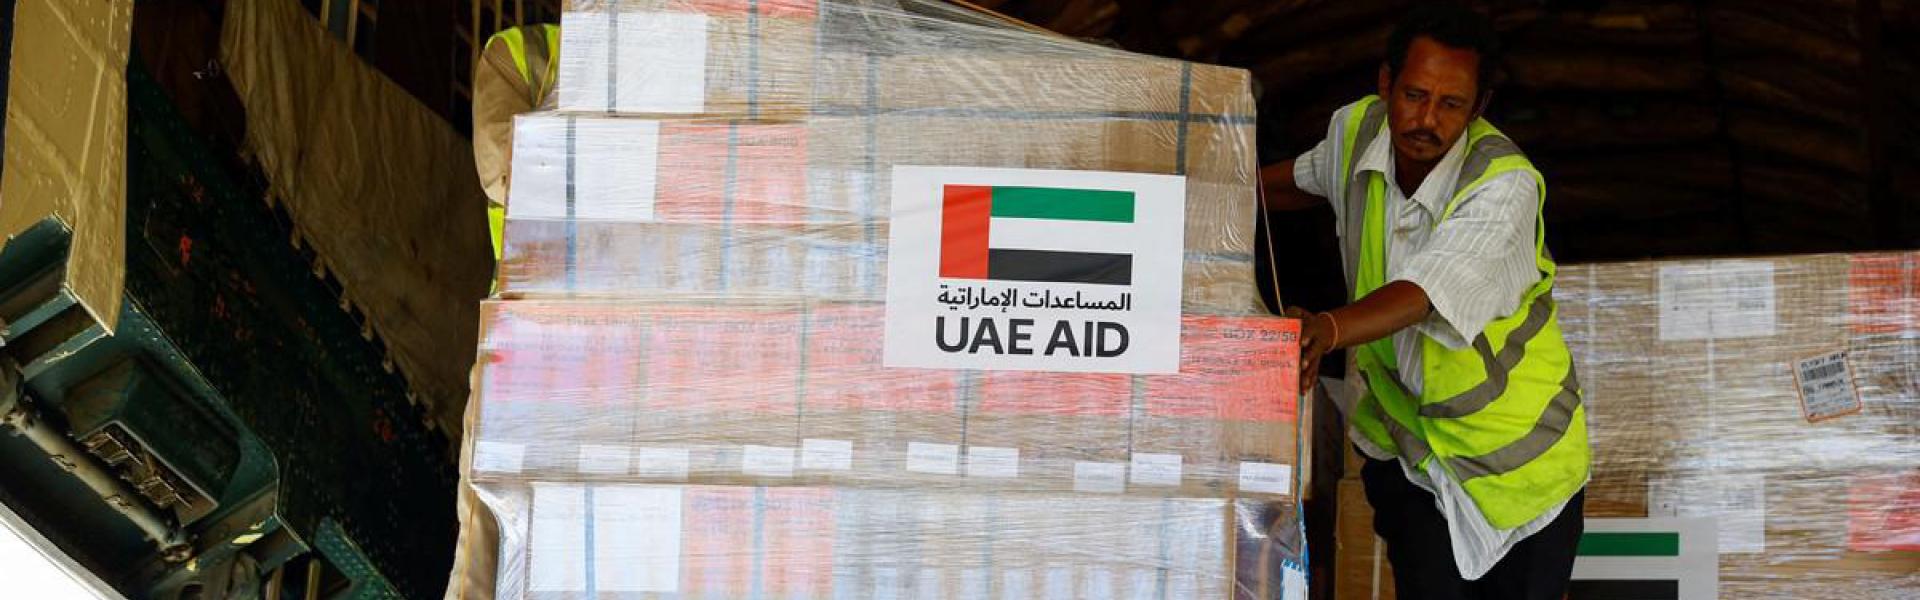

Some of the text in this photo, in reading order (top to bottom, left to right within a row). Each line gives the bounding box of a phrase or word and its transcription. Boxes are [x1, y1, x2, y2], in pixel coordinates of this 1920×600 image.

[937, 284, 1132, 313] المساعدات الإماراتية
[935, 316, 1035, 355] UAE
[1044, 319, 1130, 358] AID
